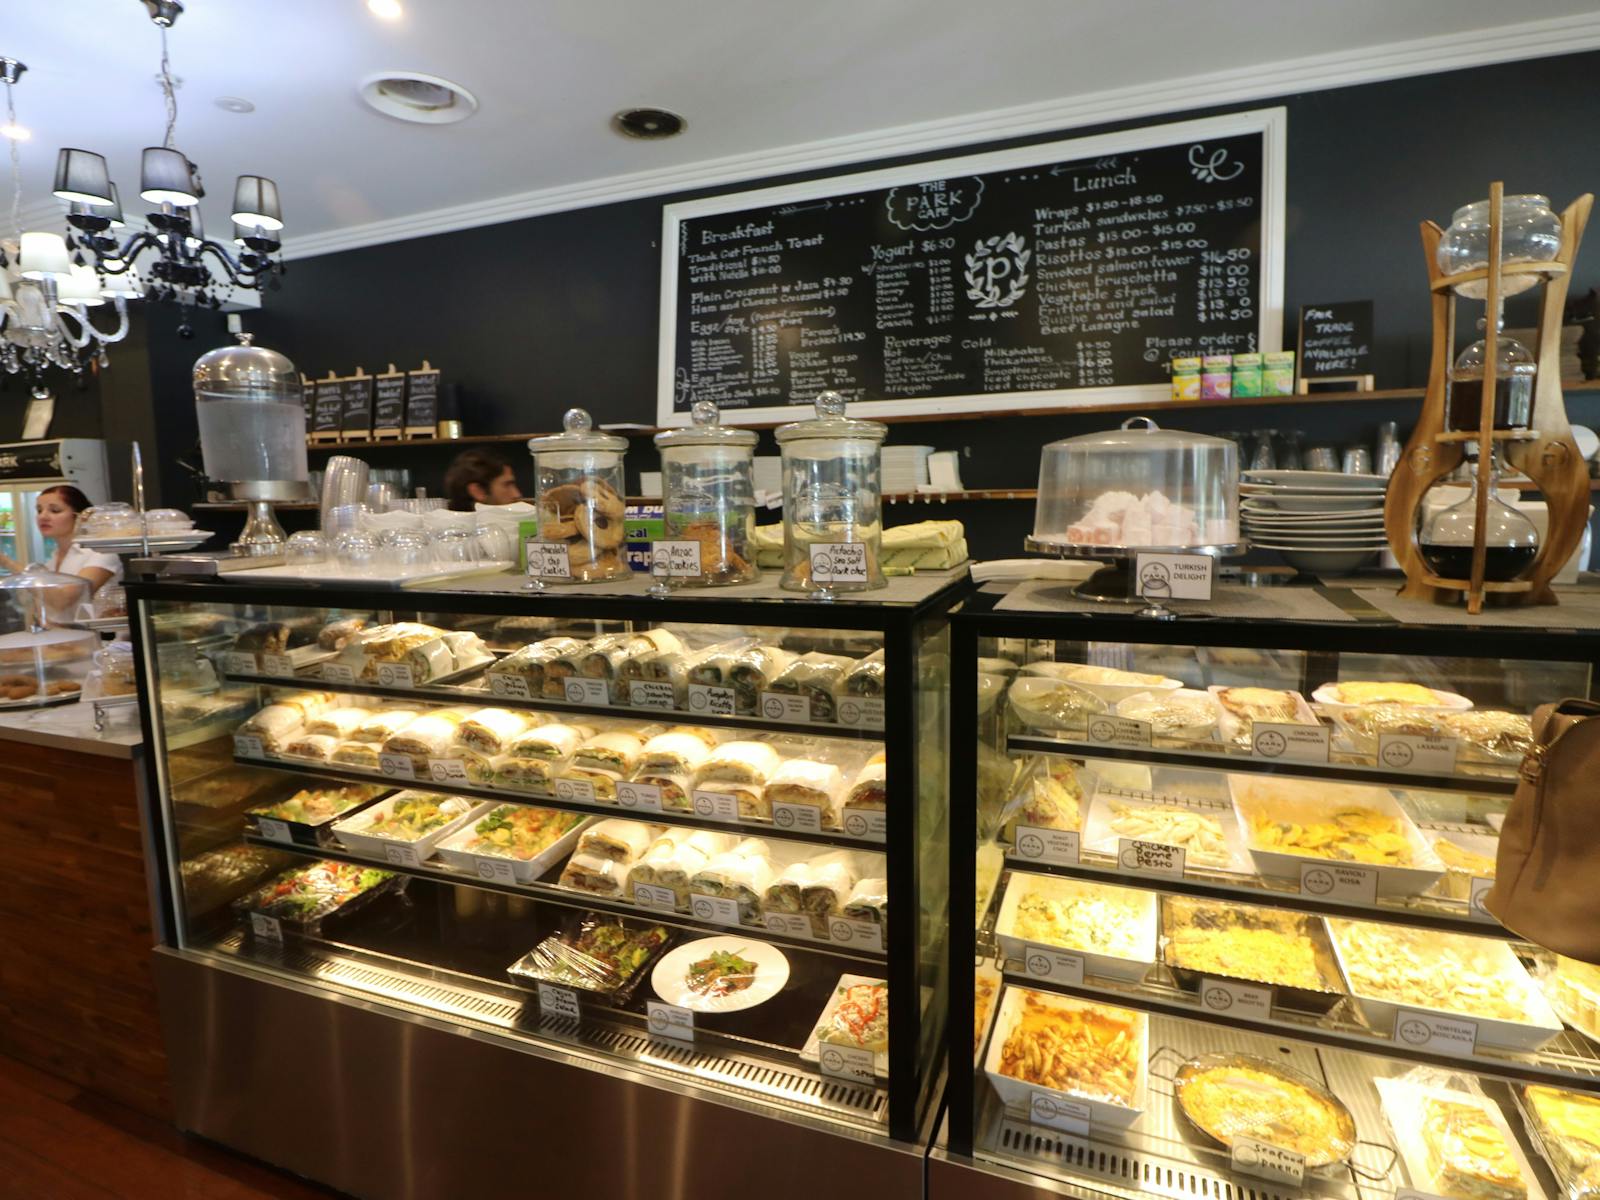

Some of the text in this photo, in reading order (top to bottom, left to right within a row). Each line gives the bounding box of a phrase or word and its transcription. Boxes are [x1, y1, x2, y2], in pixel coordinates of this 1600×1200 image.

[919, 180, 947, 192] THE
[1073, 167, 1136, 192] Lunch
[906, 189, 963, 211] PARK
[1035, 206, 1079, 221] Wraps
[1033, 217, 1091, 236] Turkish
[1096, 209, 1169, 226] sandwiches
[701, 221, 775, 245] Breakfast
[742, 240, 784, 255] French
[786, 234, 825, 249] Toast
[870, 240, 915, 263] Yogurt
[1036, 236, 1086, 252] Pastas
[1036, 249, 1102, 266] Risottos
[689, 258, 747, 275] Traditional
[1037, 263, 1093, 280] Smoked
[1098, 260, 1149, 274] salmon
[1151, 255, 1195, 268] tower
[691, 272, 717, 284] with
[1036, 279, 1089, 293] Chicken
[1094, 269, 1178, 287] bruschetta
[691, 292, 722, 305] Plain
[794, 280, 820, 291] Jam
[1038, 288, 1110, 305] Vegetable
[1113, 283, 1158, 299] stack
[691, 303, 717, 315] Ham
[720, 299, 740, 311] and
[1038, 301, 1101, 317] Frittata
[1106, 297, 1135, 309] and
[1039, 314, 1089, 327] Quiche
[1095, 310, 1125, 321] and
[1131, 305, 1175, 318] salad
[1041, 323, 1077, 335] Beef
[1081, 320, 1140, 334] Lasagne
[884, 335, 952, 348] Beverages
[961, 337, 992, 349] Cold
[1145, 332, 1245, 348] Please order
[984, 374, 1010, 383] Iced
[984, 383, 1010, 391] Iced
[671, 546, 693, 557] Anzac
[1174, 563, 1207, 571] TURKISH
[1173, 573, 1206, 581] DELIGHT
[1255, 1143, 1304, 1165] Seafood
